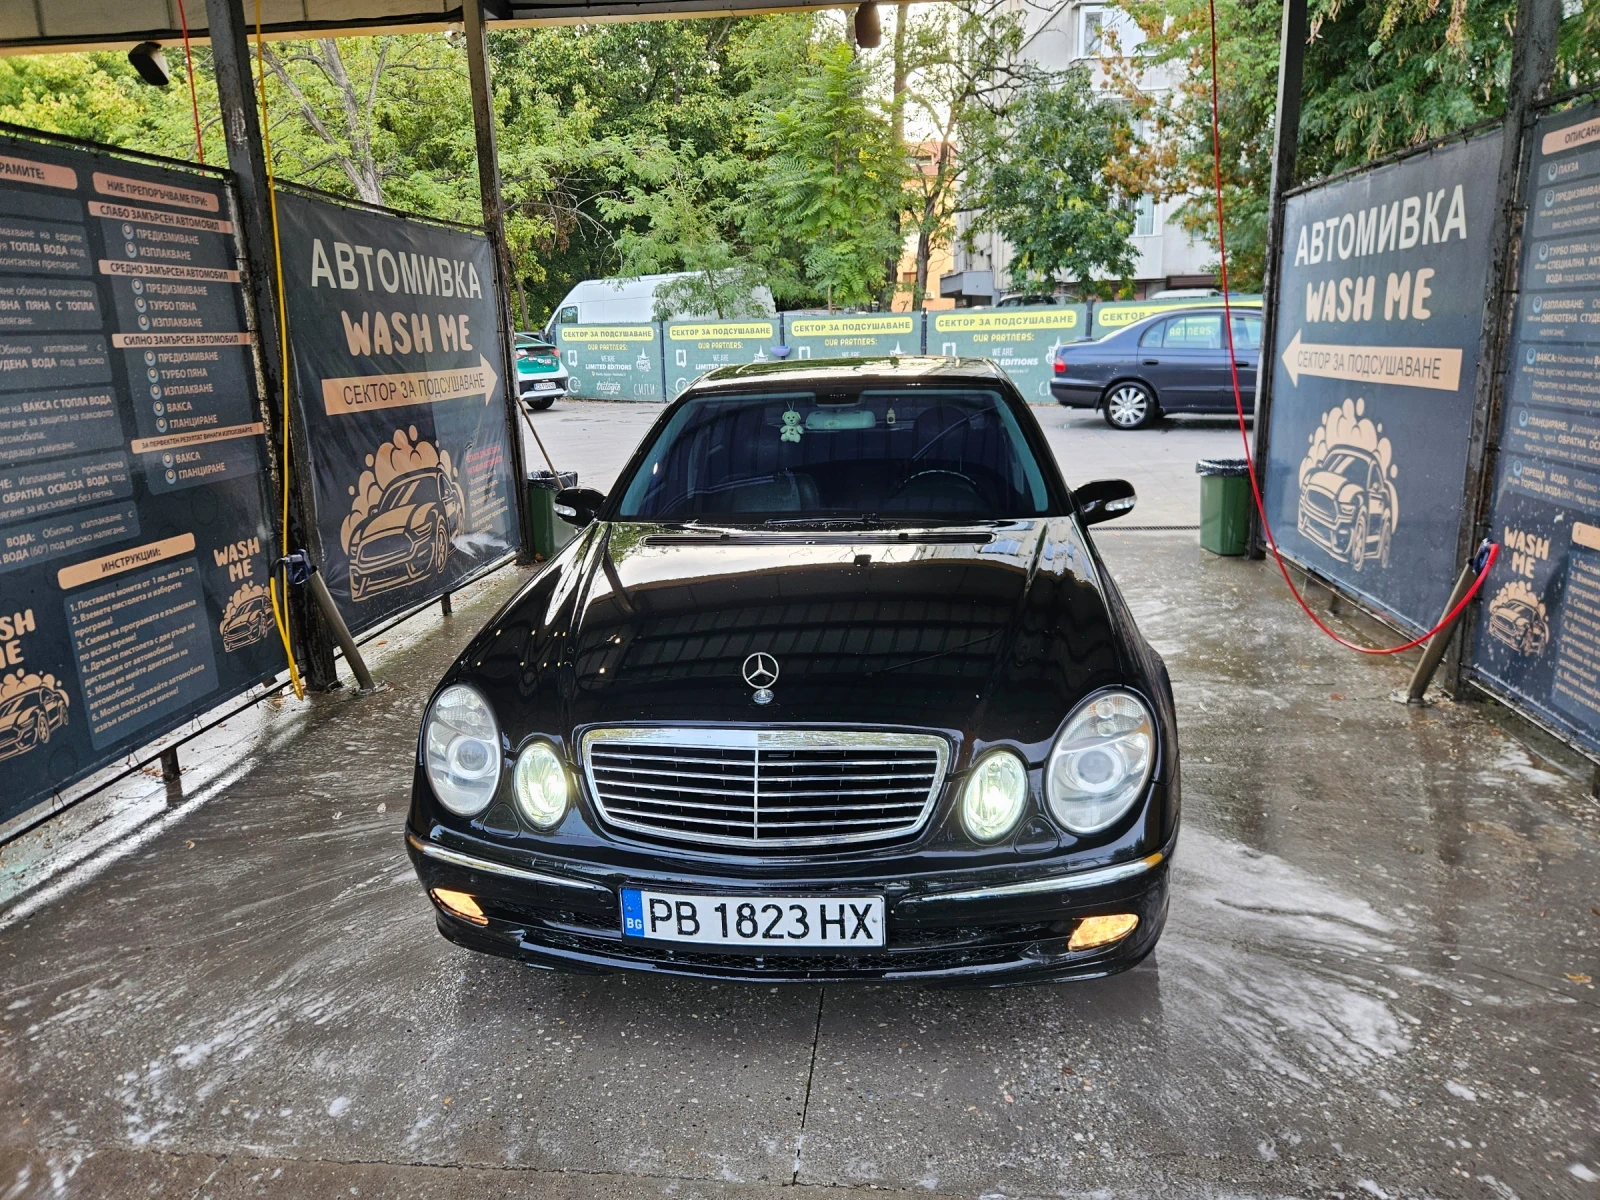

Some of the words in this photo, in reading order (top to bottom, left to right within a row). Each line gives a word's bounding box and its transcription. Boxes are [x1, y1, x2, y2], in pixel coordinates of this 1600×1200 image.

[107, 180, 125, 193] НИЕ
[100, 205, 130, 219] СЛАБО
[131, 209, 174, 225] ЗАМЪРСЕН
[175, 216, 220, 231] АВТОМОБИЛ
[1294, 184, 1467, 267] АВТОМИВКА
[136, 228, 199, 245] ПРЕДИЗМИВАНЕ
[10, 241, 41, 253] ТОПЛА
[43, 244, 68, 257] ВОДА
[139, 246, 192, 261] ИЗПЛАКВАНЕ
[110, 262, 143, 275] СРЕДНО
[145, 264, 185, 278] ЗАМЪРСЕН
[186, 269, 229, 280] АВТОМОБИЛ
[311, 238, 482, 300] АВТОМИВКА
[145, 283, 209, 296] ПРЕДИЗМИВАНЕ
[1306, 275, 1375, 323] WASH
[1384, 268, 1435, 321] ME
[66, 302, 95, 312] ТОПЛА
[149, 300, 175, 311] ТУРБО
[176, 301, 198, 311] ПЯНА
[151, 318, 203, 328] ИЗПЛАКВАНЕ
[794, 324, 826, 332] СЕКТОР
[842, 321, 911, 332] ПОДСУШАВАНЕ
[939, 319, 975, 327] СЕКТОР
[979, 318, 991, 326] ЗА
[994, 315, 1073, 327] ПОДСУШАВАНЕ
[341, 310, 433, 357] WASH
[438, 313, 473, 352] ME
[600, 330, 652, 338] ПОДСУШАВАНЕ
[712, 327, 771, 336] ПОДСУШАВАНЕ
[973, 334, 989, 342] OUR
[990, 333, 1035, 342] PARTNERS:
[1169, 325, 1215, 337] ARTNERS:
[123, 335, 153, 346] СИЛНО
[154, 335, 196, 345] ЗАМЪРСЕН
[196, 334, 239, 345] АВТОМОБИЛ
[711, 341, 744, 349] PARTNERS:
[824, 338, 838, 346] OUR
[840, 337, 878, 346] PARTNERS:
[157, 351, 219, 363] ПРЕДИЗМИВАНЕ
[992, 348, 1001, 356] WE
[1002, 348, 1014, 356] ARE
[31, 358, 57, 369] ВОДА
[1001, 357, 1039, 366] EDITIONS
[1297, 350, 1331, 369] СЕКТОР
[1333, 354, 1345, 371] ЗА
[1348, 354, 1442, 380] ПОДСУШАВАНЕ
[161, 369, 186, 379] ТУРБО
[187, 368, 208, 378] ПЯНА
[163, 383, 214, 396] ИЗПЛАКВАНЕ
[343, 382, 397, 405] СЕКТОР
[400, 380, 416, 399] ЗА
[418, 372, 485, 398] ПОДСУШАВАНЕ
[22, 399, 52, 413] ВАКСА
[60, 397, 89, 409] ТОПЛА
[88, 395, 112, 406] ВОДА
[166, 401, 193, 413] ВАКСА
[169, 414, 218, 429] ГЛАНЦИРАНЕ
[175, 451, 201, 464] ВАКСА
[178, 462, 226, 479] ГЛАНЦИРАНЕ
[2, 487, 44, 504] ОБРАТНА
[47, 480, 85, 495] ОСМОЗА
[86, 475, 110, 488] ВОДА
[6, 533, 36, 548] ВОДА:
[1504, 526, 1549, 560] WASH
[2, 548, 30, 563] ВОДА
[213, 536, 261, 567] WASH
[101, 548, 162, 573] ИНСТРУКЦИИ:
[1512, 552, 1536, 579] ME
[229, 561, 254, 582] ME
[77, 591, 116, 610] Поставете
[626, 917, 643, 930] BG
[649, 898, 700, 936] PB
[714, 903, 810, 939] 1823
[820, 904, 873, 940] HX
